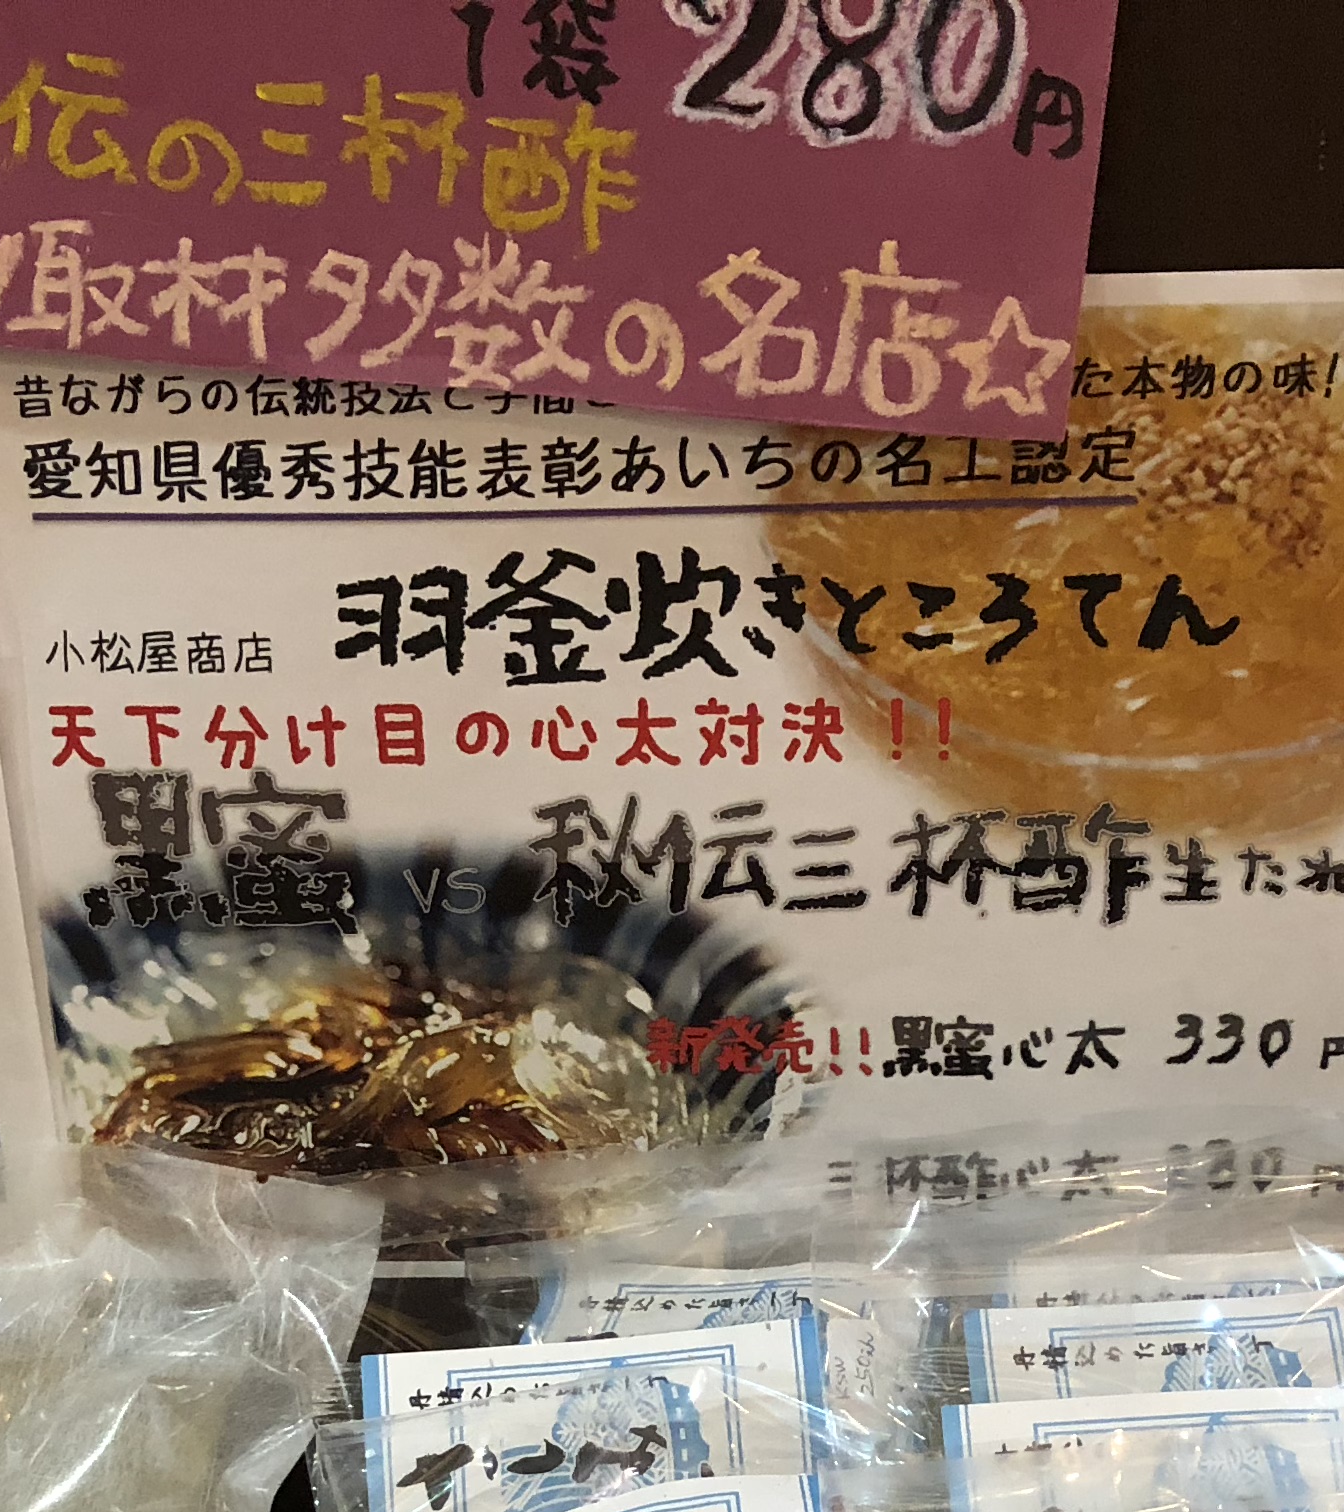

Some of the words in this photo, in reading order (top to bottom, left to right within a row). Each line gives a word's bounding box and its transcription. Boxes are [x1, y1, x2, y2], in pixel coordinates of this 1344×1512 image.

[44, 631, 274, 674] 小松屋商店
